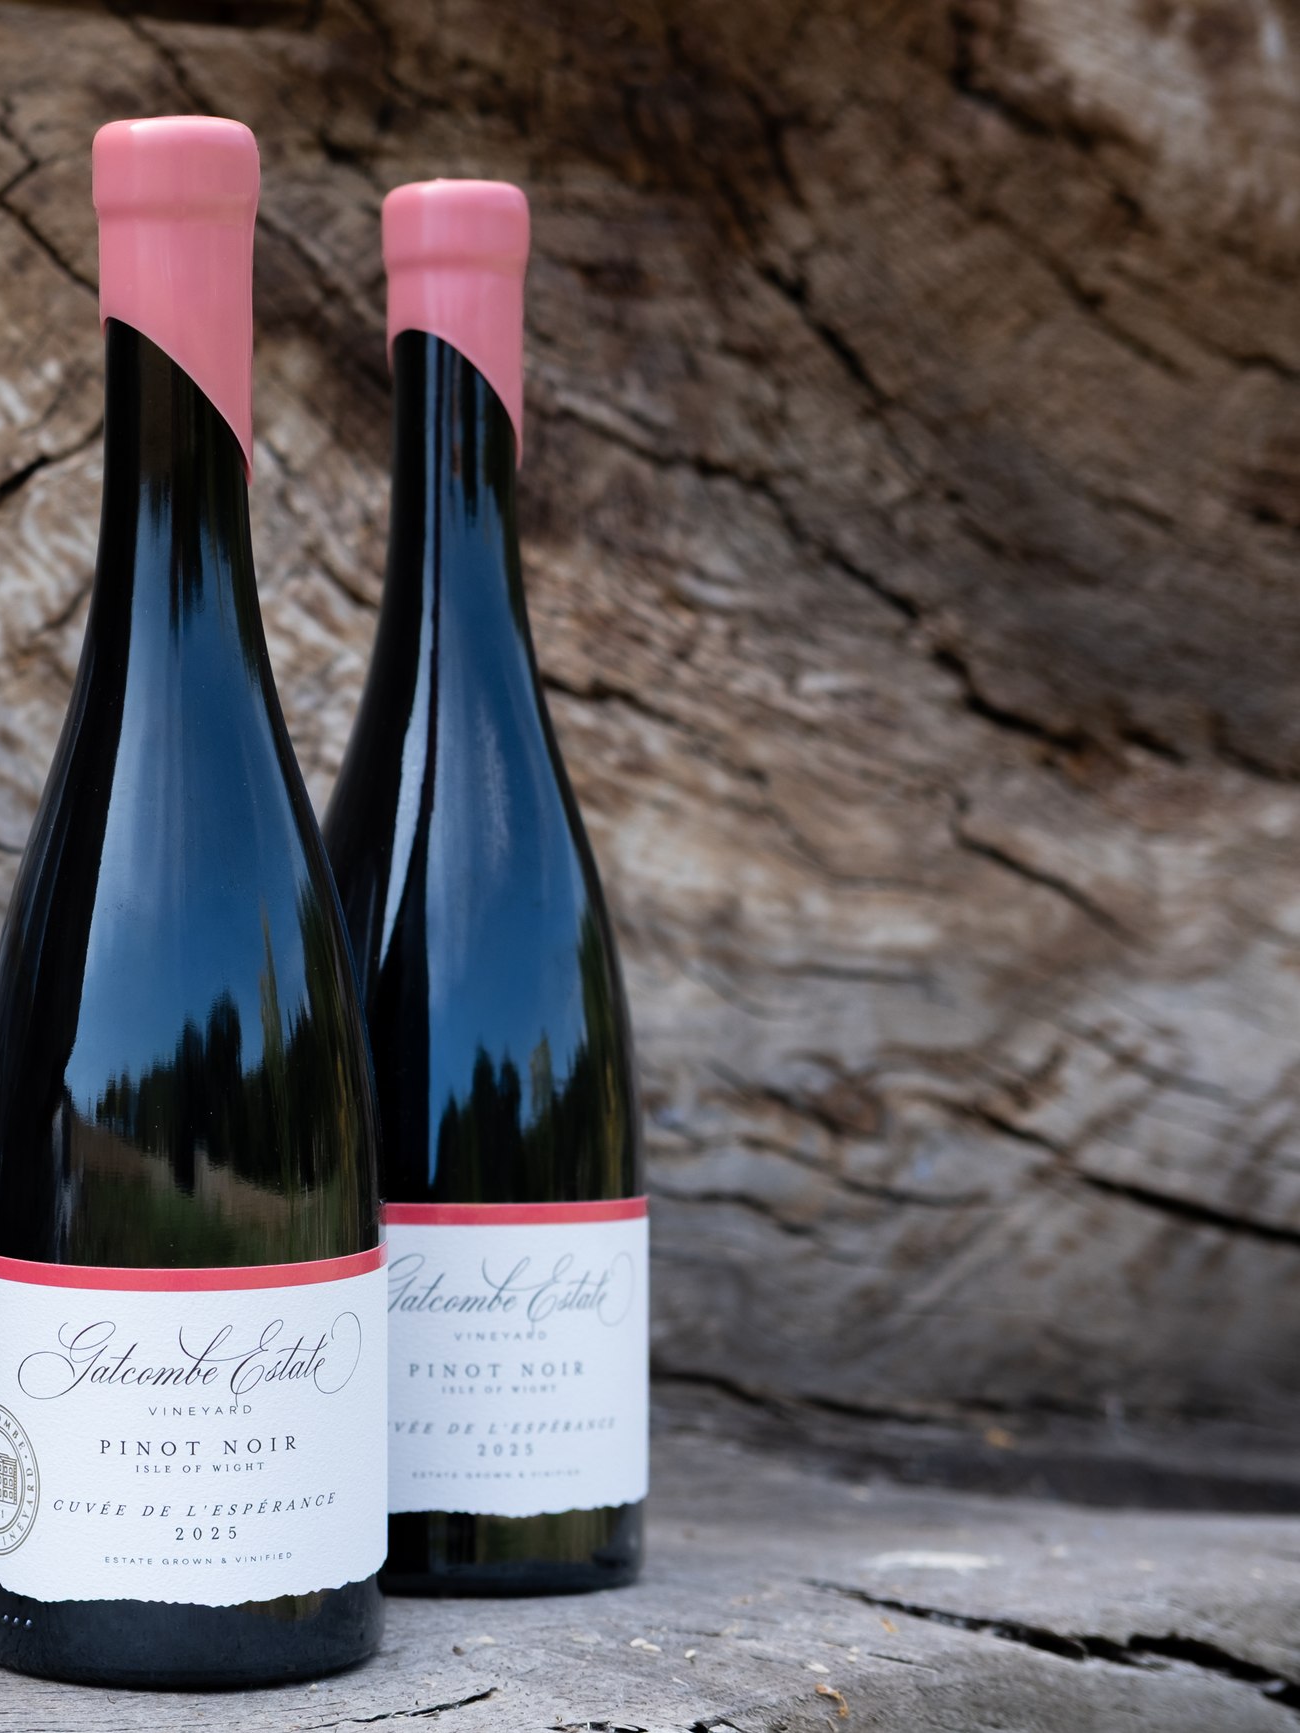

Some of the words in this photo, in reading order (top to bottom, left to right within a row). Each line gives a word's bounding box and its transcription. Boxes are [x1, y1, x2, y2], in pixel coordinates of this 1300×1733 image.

[527, 1252, 635, 1331] Estate
[453, 1331, 547, 1341] VINEYARD
[17, 1320, 233, 1400] Gatcombe
[229, 1311, 362, 1406] Estate
[408, 1363, 501, 1379] PINOT
[521, 1360, 585, 1377] NOIR
[441, 1385, 475, 1395] ISLE
[484, 1385, 502, 1395] OF
[148, 1404, 252, 1417] VINEYARD
[387, 1419, 434, 1435] VÉE
[447, 1422, 475, 1435] DE
[99, 1439, 201, 1456] PINOT
[223, 1435, 297, 1454] NOIR
[477, 1443, 534, 1457] 2025
[135, 1464, 171, 1474] ISLE
[182, 1464, 202, 1474] OF
[212, 1461, 265, 1473] WIGHT
[53, 1499, 127, 1516] CUVÉE
[142, 1505, 172, 1517] DE
[186, 1491, 336, 1517] L'ESPÉRANCE
[175, 1526, 238, 1541] 2025
[104, 1556, 153, 1565] ESTATE
[161, 1557, 212, 1566] GROWN
[220, 1557, 227, 1565] &
[235, 1552, 293, 1564] VINIFIED
